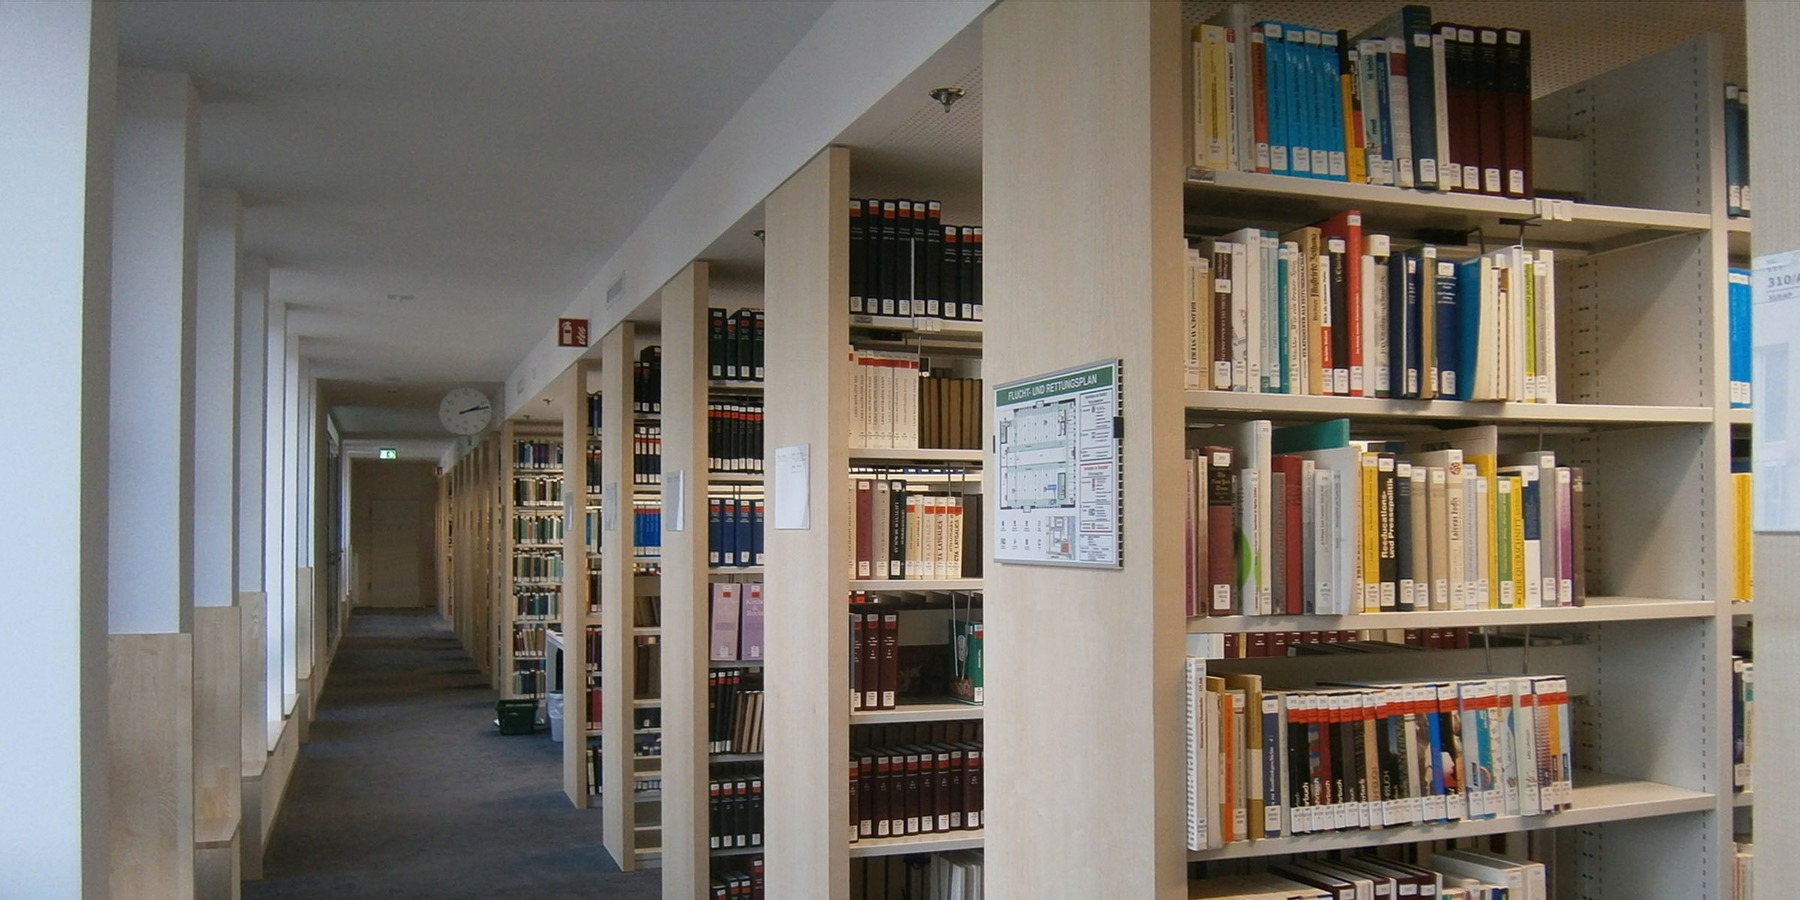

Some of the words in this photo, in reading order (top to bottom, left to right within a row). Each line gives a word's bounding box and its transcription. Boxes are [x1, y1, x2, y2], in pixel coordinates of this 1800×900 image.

[1008, 387, 1031, 401] FLUCHT-
[1032, 385, 1045, 397] UND
[1046, 374, 1098, 394] RETTUNGSPLAN
[1387, 478, 1395, 538] Pressepolitik
[1514, 518, 1523, 577] QUERSCHNITT
